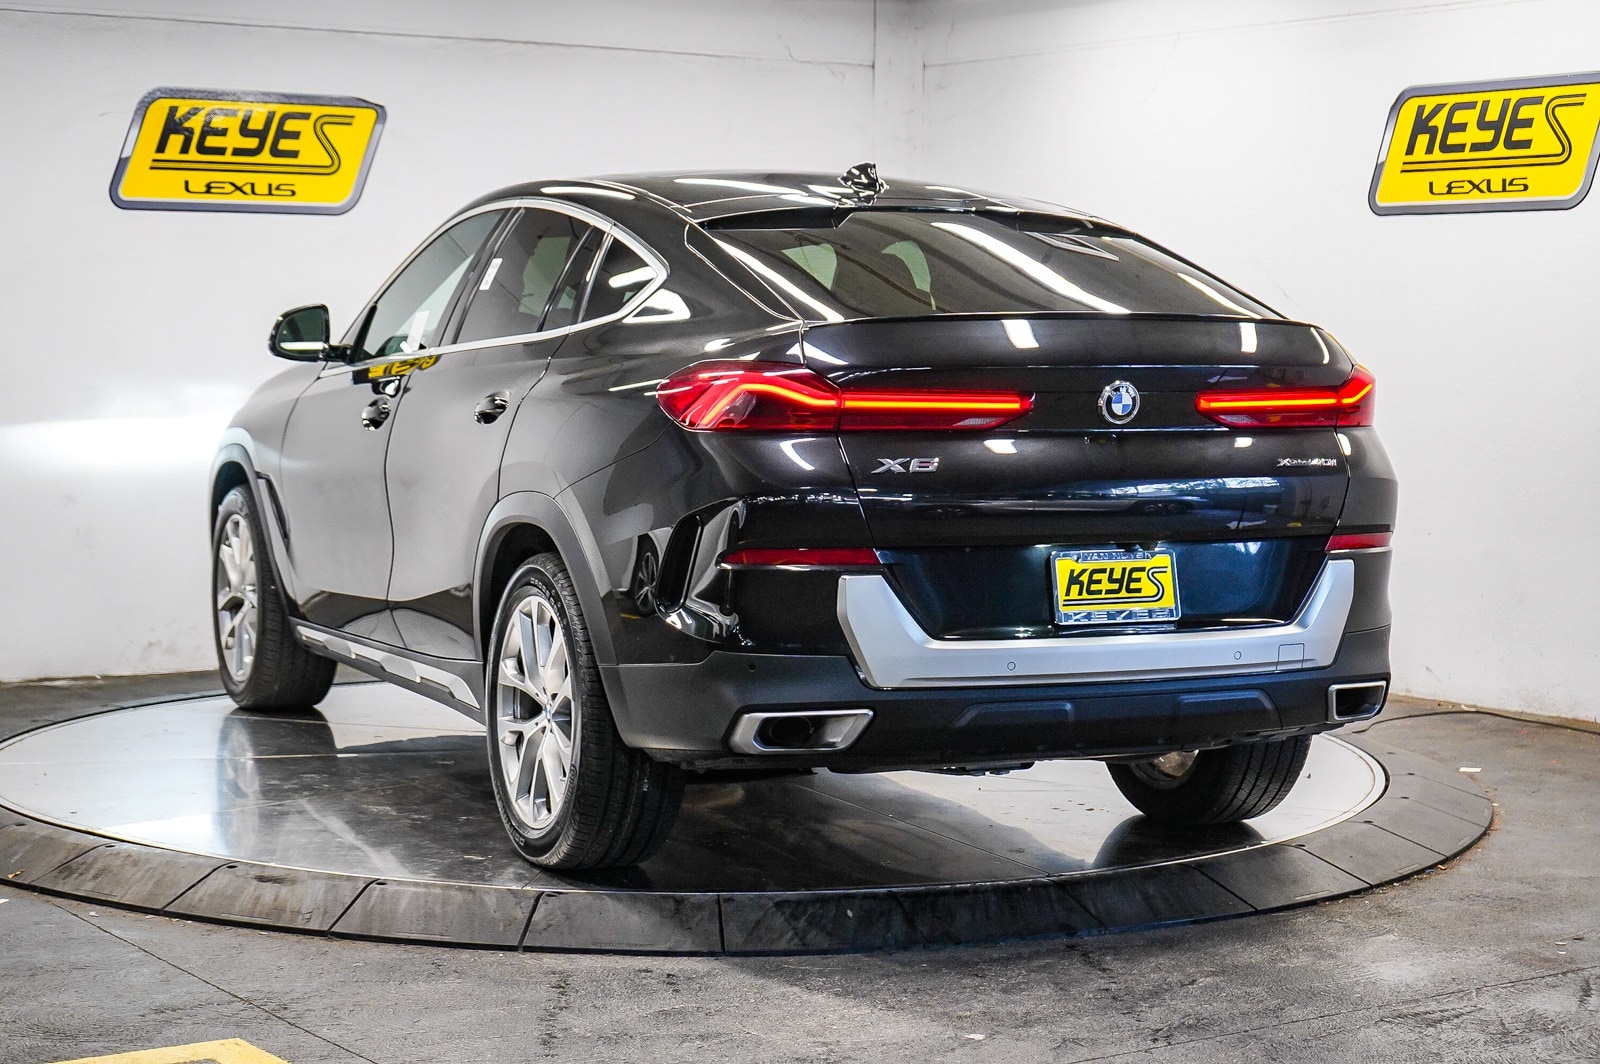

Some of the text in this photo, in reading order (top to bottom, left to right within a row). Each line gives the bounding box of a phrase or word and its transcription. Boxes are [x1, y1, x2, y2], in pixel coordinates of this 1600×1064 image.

[150, 105, 355, 175] KEYES
[1401, 93, 1587, 173] KEYES
[184, 180, 296, 196] LEXUS
[1428, 177, 1529, 195] LEXUS
[870, 457, 940, 474] X6
[1062, 566, 1168, 606] KEYES
